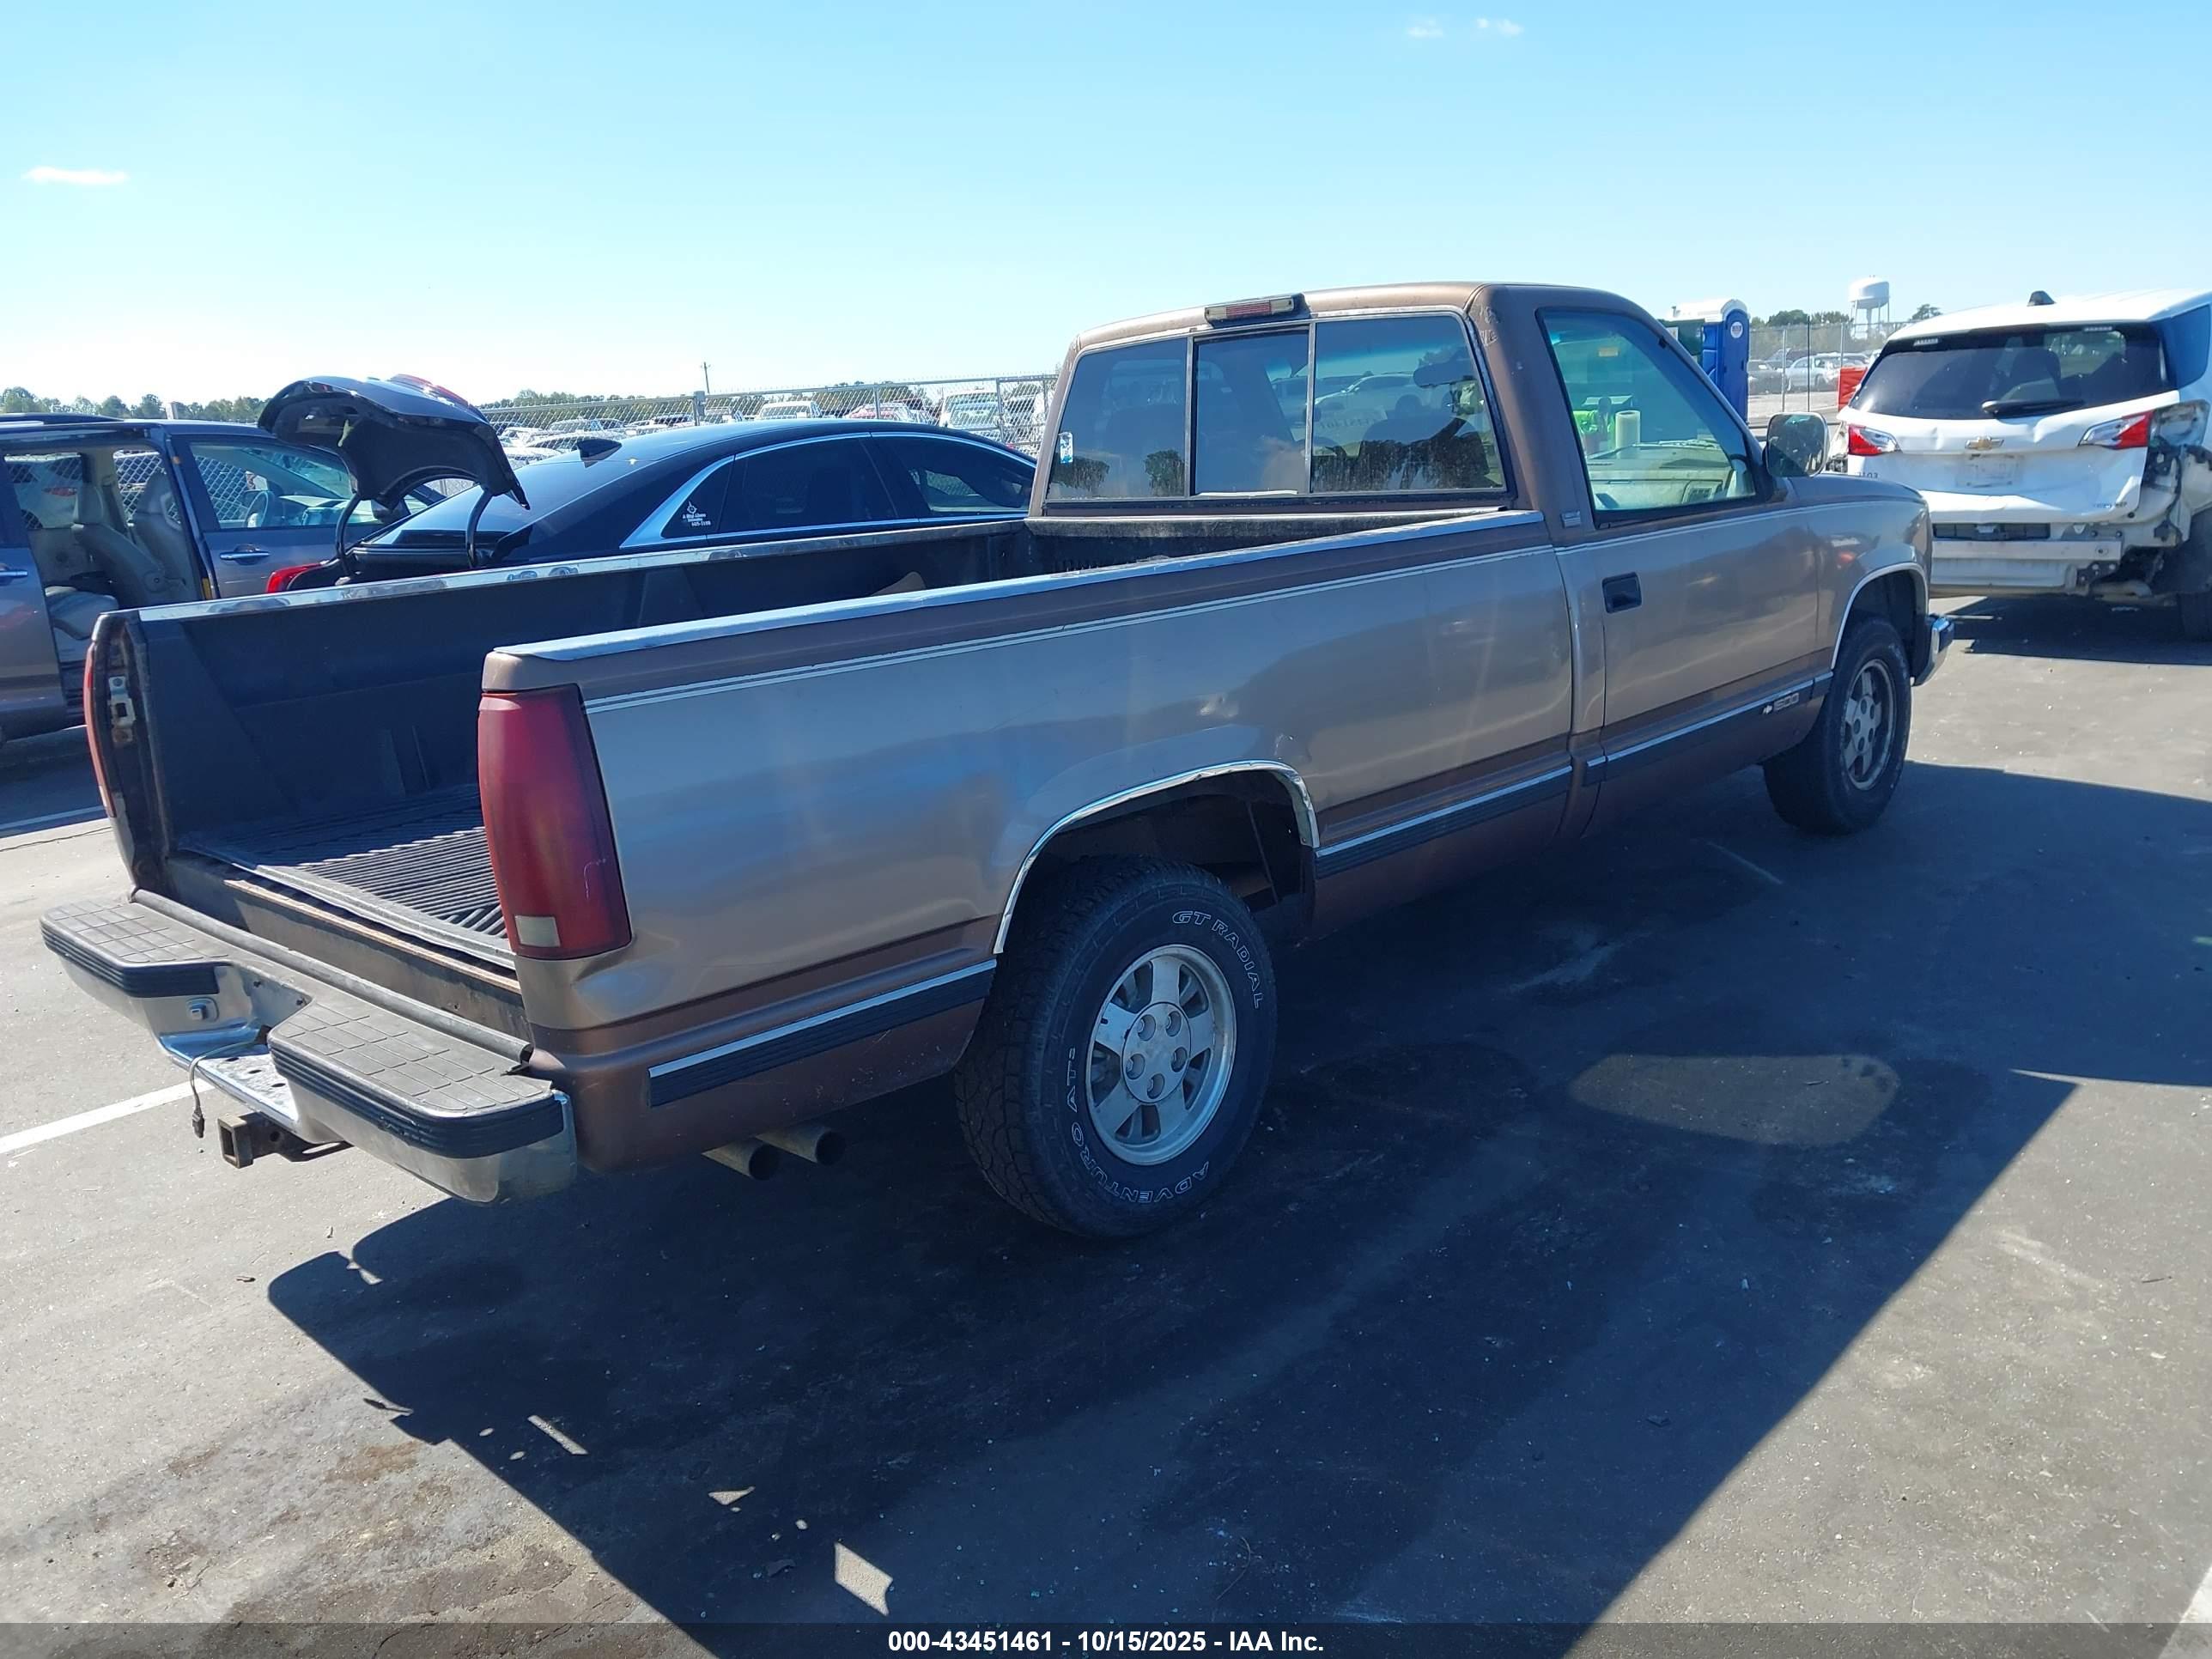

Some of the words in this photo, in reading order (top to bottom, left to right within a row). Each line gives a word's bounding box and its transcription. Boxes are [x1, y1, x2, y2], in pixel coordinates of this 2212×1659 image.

[1172, 910, 1212, 926] GT
[1211, 919, 1263, 1009] RADIAL
[1072, 1121, 1209, 1203] ADVENTURO
